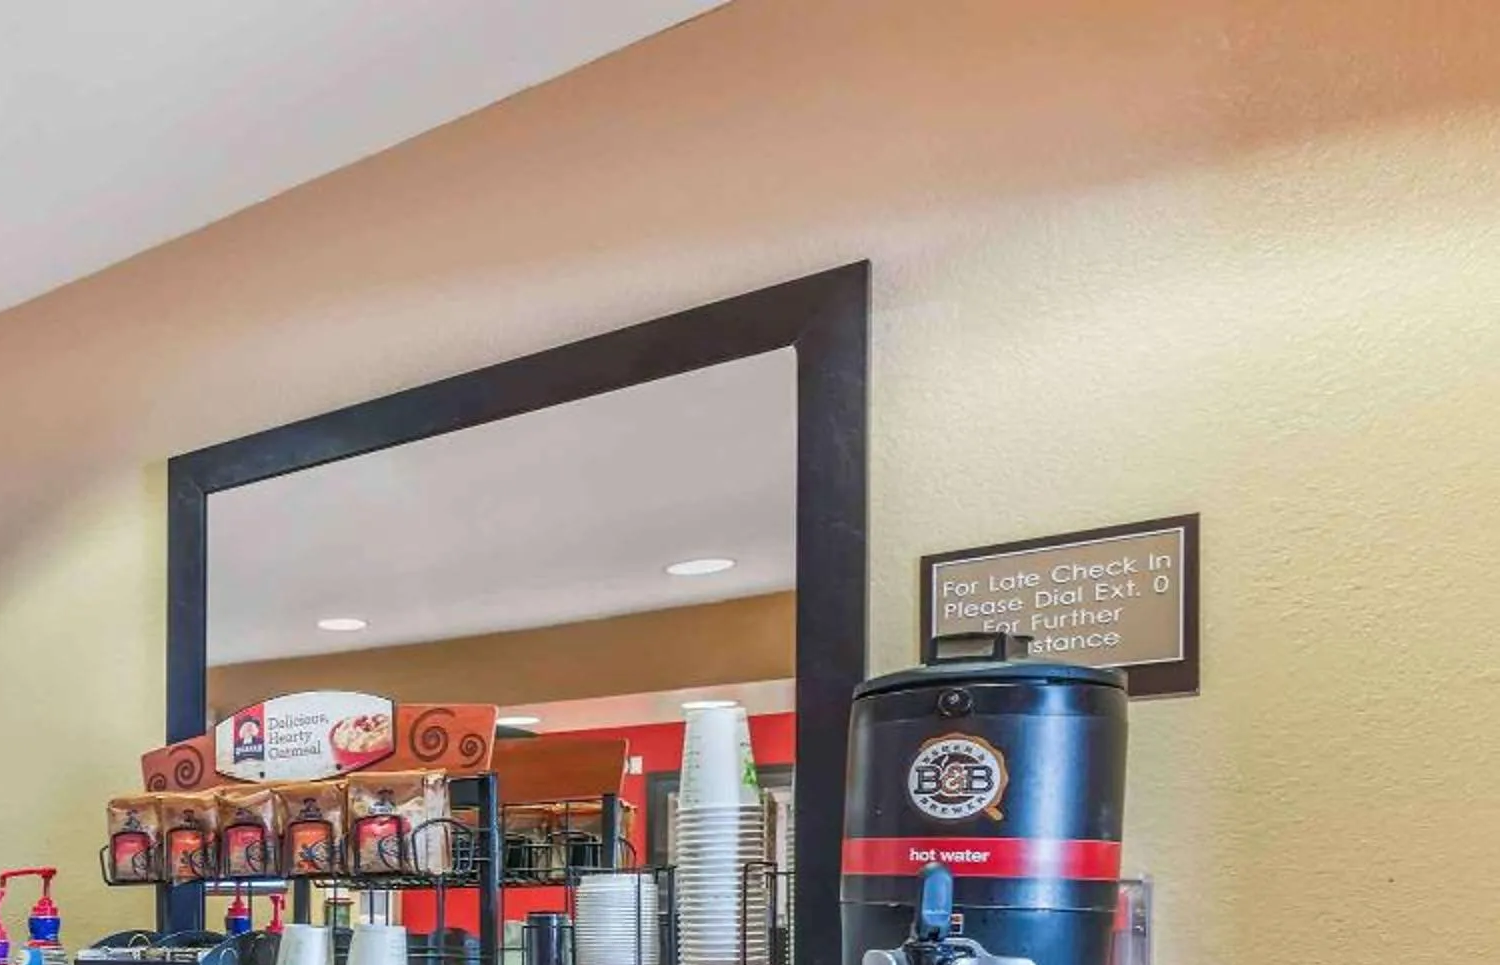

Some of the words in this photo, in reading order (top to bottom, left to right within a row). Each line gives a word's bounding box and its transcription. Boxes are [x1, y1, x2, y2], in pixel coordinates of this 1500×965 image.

[943, 580, 978, 597] For
[990, 572, 1040, 592] Late
[1052, 557, 1138, 583] Check
[1149, 554, 1171, 571] In
[944, 598, 1023, 619] Please
[1035, 587, 1082, 608] Dial
[1095, 580, 1140, 600] Ext.
[1154, 576, 1169, 593] 0
[983, 619, 1020, 633] For
[1031, 607, 1123, 630] Further
[1028, 632, 1121, 653] istance
[269, 729, 312, 745] Hearty
[909, 848, 935, 861] hot
[940, 849, 991, 862] water
